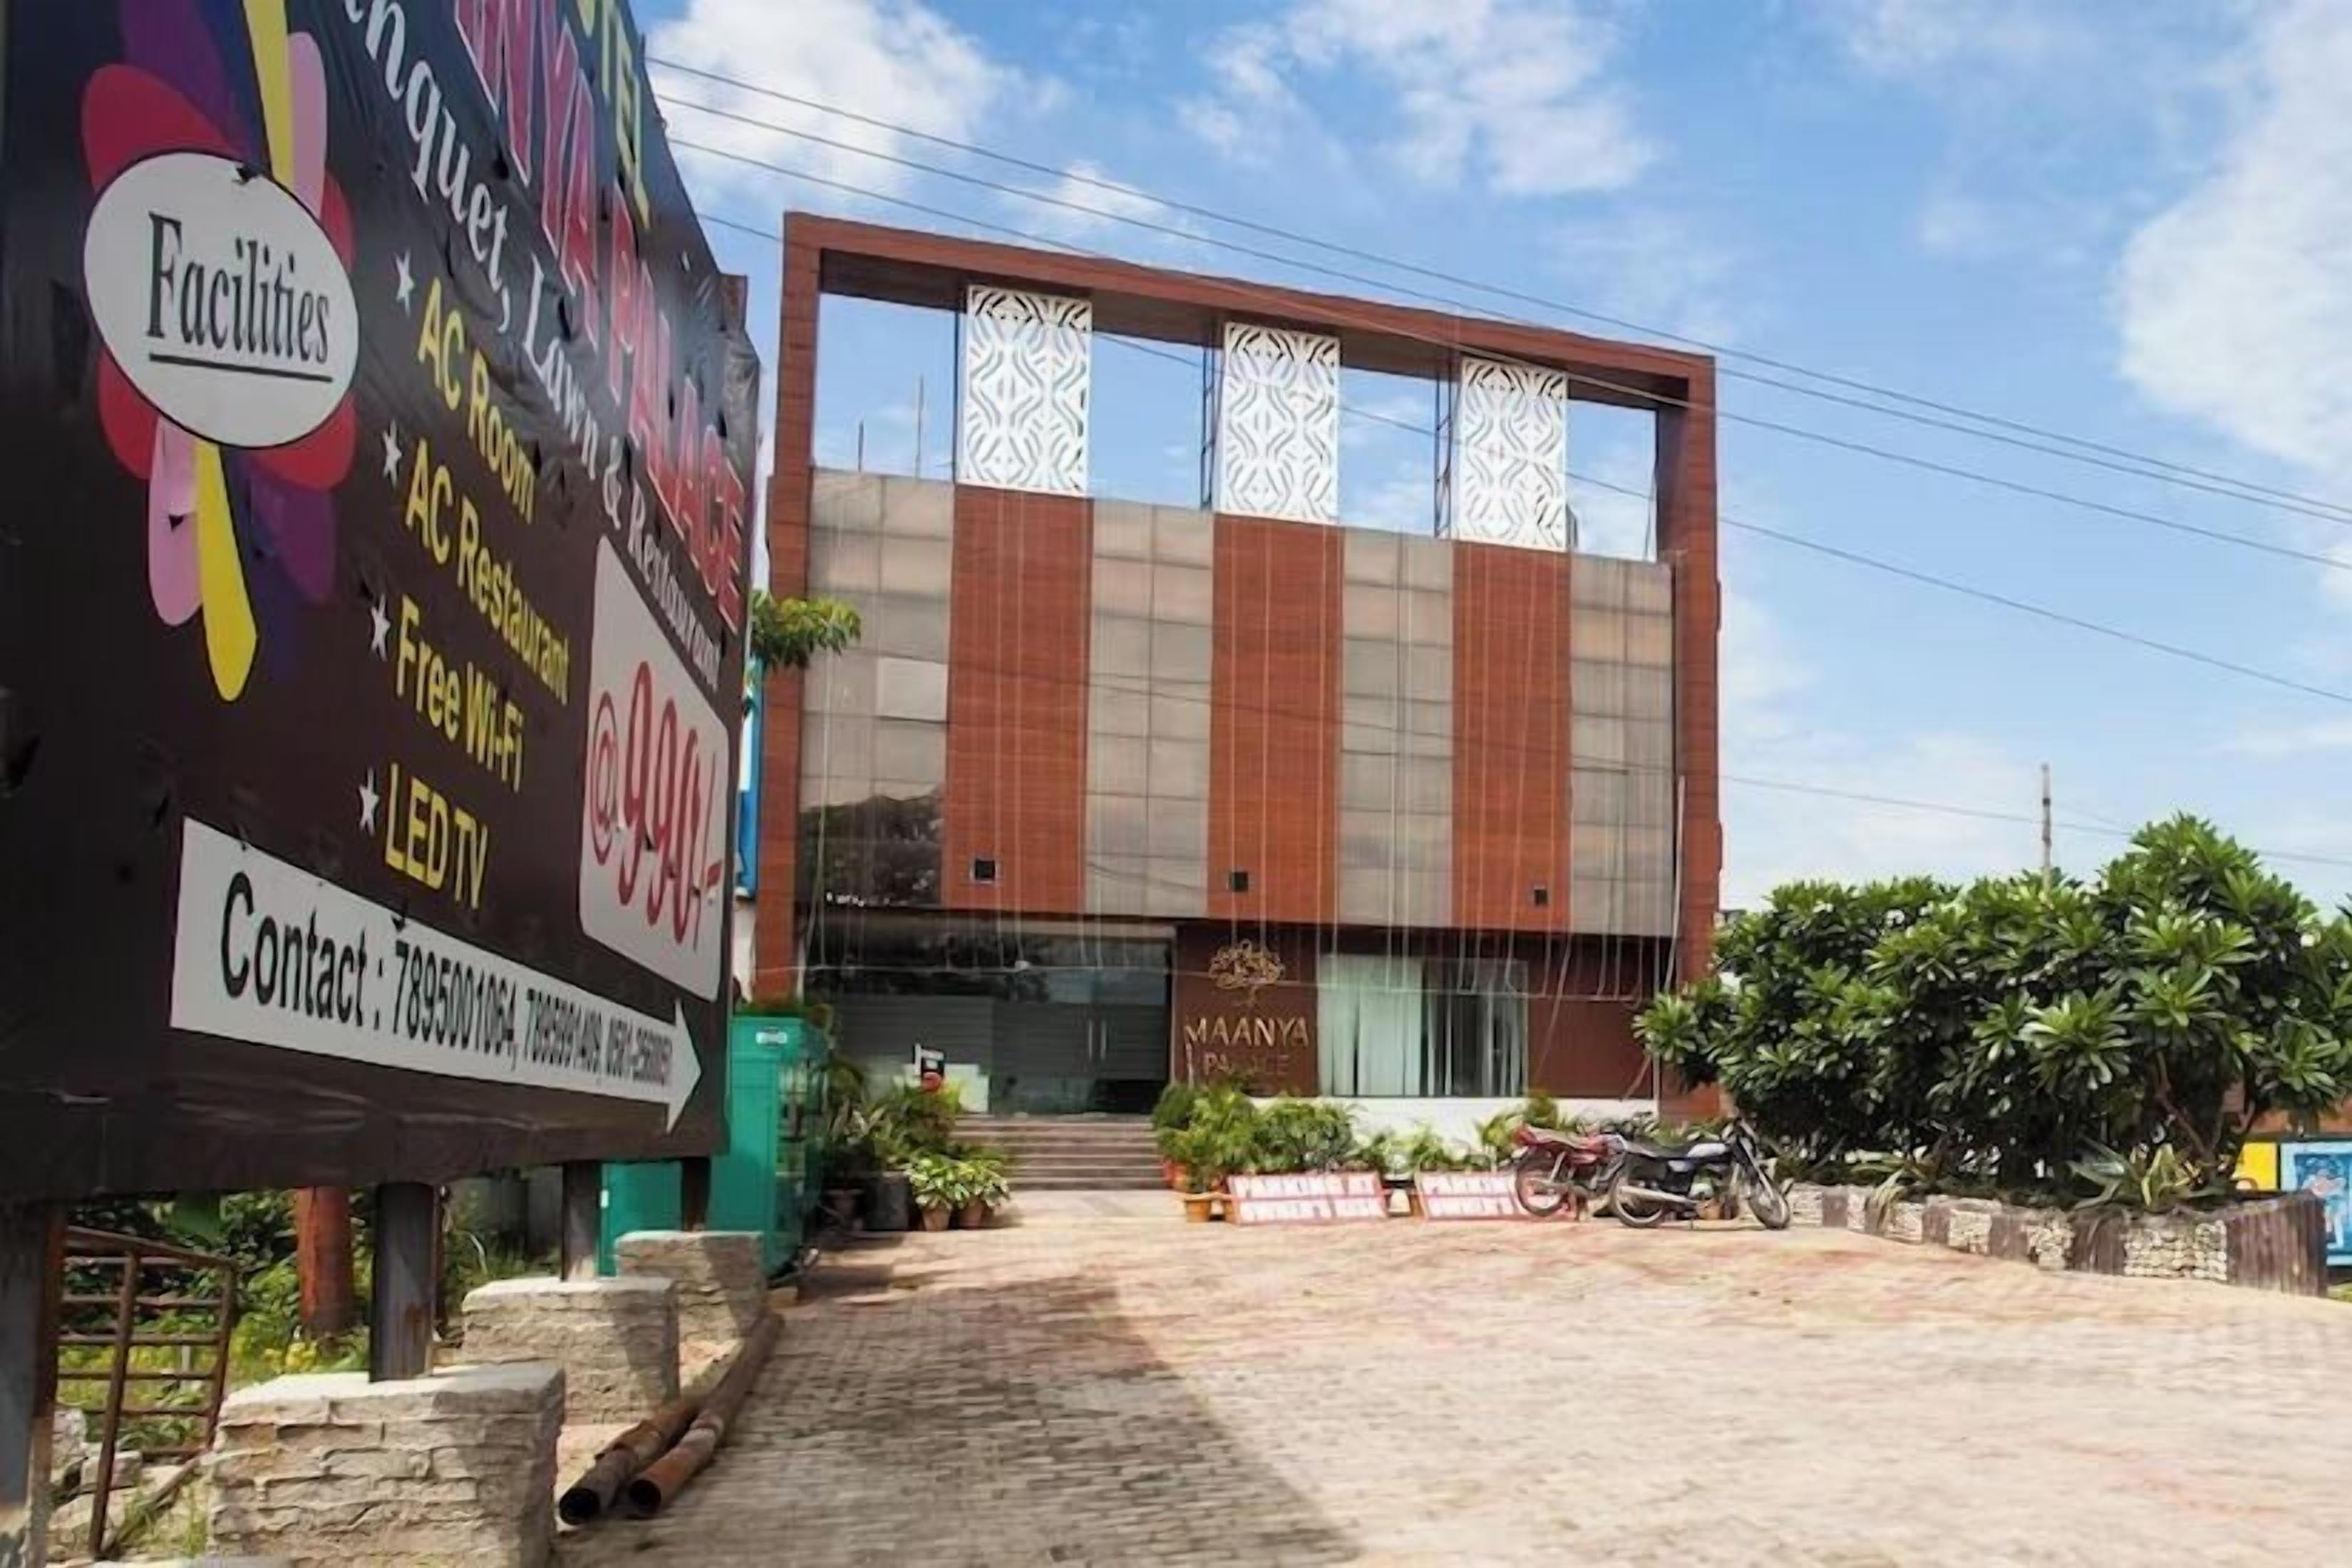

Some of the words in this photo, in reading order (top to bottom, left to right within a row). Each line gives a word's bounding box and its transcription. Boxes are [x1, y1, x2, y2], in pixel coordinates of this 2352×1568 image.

[146, 211, 331, 364] Facilities
[418, 277, 464, 411] AC
[468, 346, 535, 525] Room
[406, 438, 453, 564] AC
[457, 495, 570, 706] Restaurant
[396, 594, 461, 741] Free
[465, 660, 524, 793] Wi-Fi
[385, 763, 449, 891] LED
[454, 807, 488, 911] TV
[220, 869, 367, 1028] Contact
[1183, 1016, 1309, 1047] MAANYA
